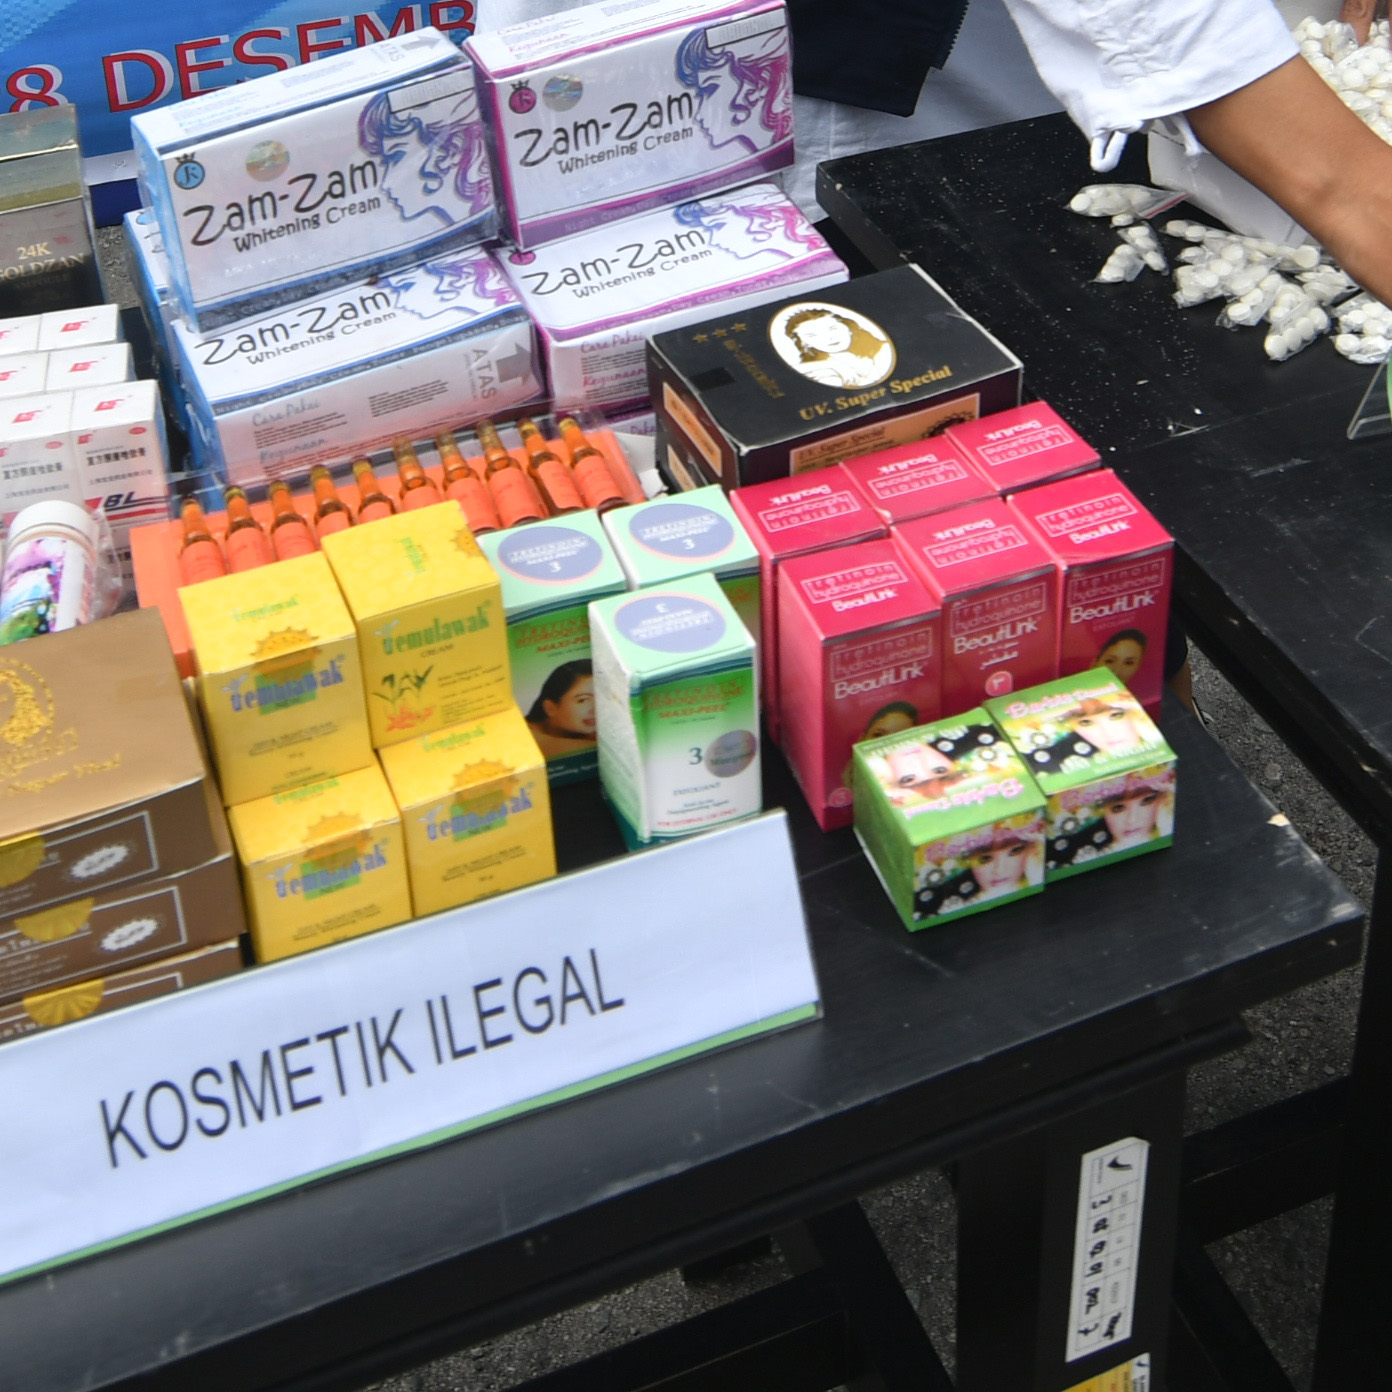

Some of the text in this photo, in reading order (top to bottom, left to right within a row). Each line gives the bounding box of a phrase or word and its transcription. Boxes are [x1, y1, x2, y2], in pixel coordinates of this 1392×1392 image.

[514, 90, 693, 168] Zam-Zam
[557, 126, 693, 175] Whitening Cream
[182, 157, 379, 247] Zam-Zam
[234, 195, 382, 254] Whitening Cream
[17, 242, 53, 260] 24K
[522, 226, 707, 297] Zam-Zam
[571, 247, 713, 300] Whitening Cream
[194, 287, 392, 367] Zam-Zam
[246, 311, 397, 366] Whitening Cream
[473, 348, 497, 400] ATAS
[837, 381, 888, 411] Super
[890, 365, 953, 394] Special
[102, 490, 136, 509] BL
[549, 561, 562, 574] 3
[682, 538, 696, 550] 3
[374, 602, 491, 655] Temulawak
[689, 747, 704, 765] 3
[98, 947, 627, 1170] KOSMETIK ILEGAL
